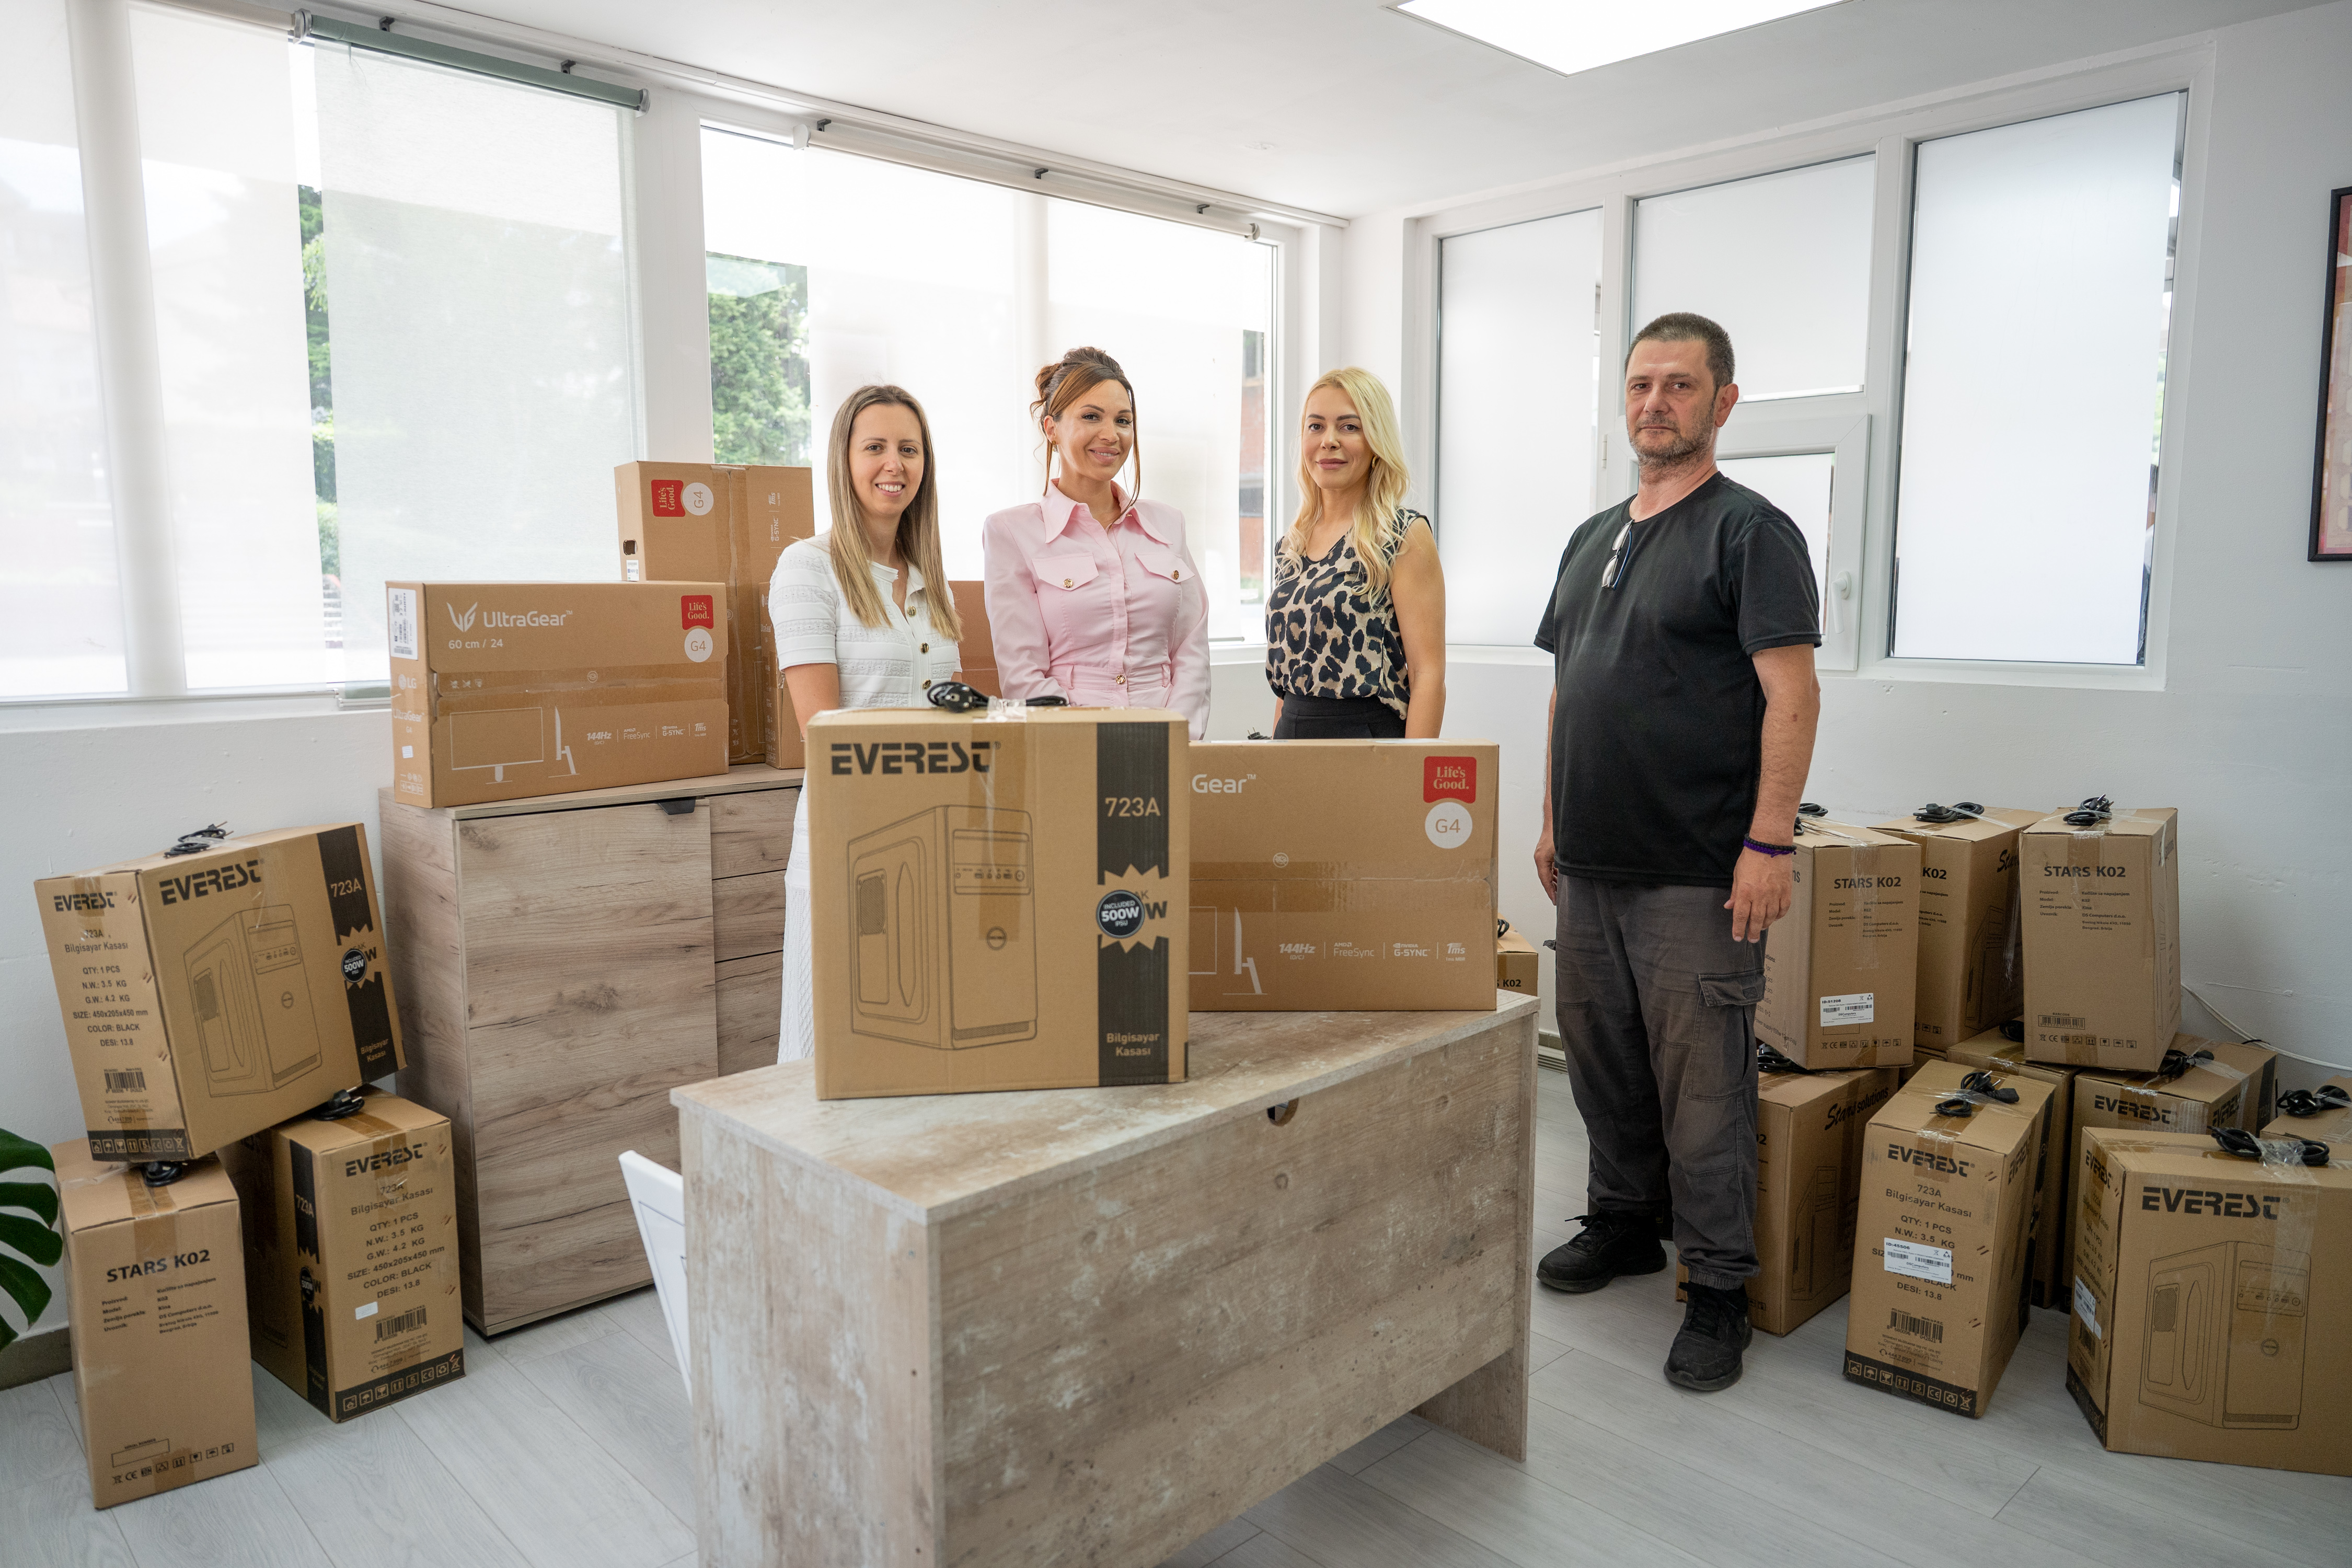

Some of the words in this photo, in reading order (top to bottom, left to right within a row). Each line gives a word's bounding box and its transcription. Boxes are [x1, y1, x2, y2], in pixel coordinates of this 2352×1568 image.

[659, 487, 667, 508] Life's
[666, 485, 675, 510] Good.
[694, 490, 704, 509] G4
[689, 602, 707, 611] Life's
[688, 611, 709, 619] Good.
[448, 640, 462, 649] 60
[482, 639, 487, 648] /
[490, 639, 503, 648] 24
[691, 641, 706, 651] G4
[407, 677, 417, 688] LG
[587, 732, 612, 741] 144Hz
[624, 732, 651, 740] FreeSync
[1436, 766, 1466, 778] Life's
[1433, 778, 1470, 790] Good.
[1105, 797, 1160, 817] 723A
[1435, 818, 1461, 833] G4
[1922, 867, 1947, 880] K02
[2044, 866, 2091, 877] STARS
[2097, 866, 2126, 877] K02
[331, 879, 362, 897] 723A
[1834, 878, 1873, 889] STARS
[1877, 877, 1901, 887] K02
[1104, 900, 1136, 909] INCLUDED
[1101, 906, 1139, 922] 500W
[65, 943, 101, 954] Bilgisayar
[1279, 943, 1316, 954] 144Hz
[1333, 948, 1375, 959] FreeSync
[1447, 943, 1466, 954] 1ms
[344, 960, 364, 972] 500W
[93, 1009, 134, 1018] 450x205x450
[1106, 1032, 1160, 1045] Bilgisayar
[361, 1039, 389, 1055] Bilgisayar
[1857, 1087, 1889, 1114] solutions
[381, 1183, 405, 1195] 723A
[1917, 1184, 1942, 1198] 723A
[1886, 1189, 1935, 1208] Bilgisayar
[351, 1196, 399, 1216] Bilgisayar
[370, 1221, 390, 1232] QTY:
[400, 1213, 419, 1223] PCS
[1901, 1215, 1922, 1227] QTY:
[1933, 1224, 1952, 1235] PCS
[366, 1236, 388, 1247] N.W.:
[392, 1229, 405, 1239] 3.5
[411, 1224, 424, 1234] KG
[1895, 1227, 1918, 1239] N.W.:
[1921, 1233, 1935, 1243] 3.5
[1941, 1239, 1955, 1249] KG
[367, 1249, 389, 1260] G.W.:
[393, 1242, 406, 1252] 4.2
[412, 1237, 425, 1247] KG
[107, 1258, 168, 1283] STARS
[174, 1249, 211, 1269] K02
[348, 1269, 371, 1281] SIZE:
[373, 1250, 428, 1272] 450x205x450
[430, 1246, 445, 1255] mm
[364, 1273, 399, 1289] COLOR:
[401, 1262, 432, 1277] BLACK
[1957, 1272, 1974, 1283] mm
[377, 1287, 401, 1299] DESI:
[403, 1279, 420, 1290] 13.8
[1897, 1282, 1921, 1295] DESI:
[1924, 1290, 1942, 1301] 13.8
